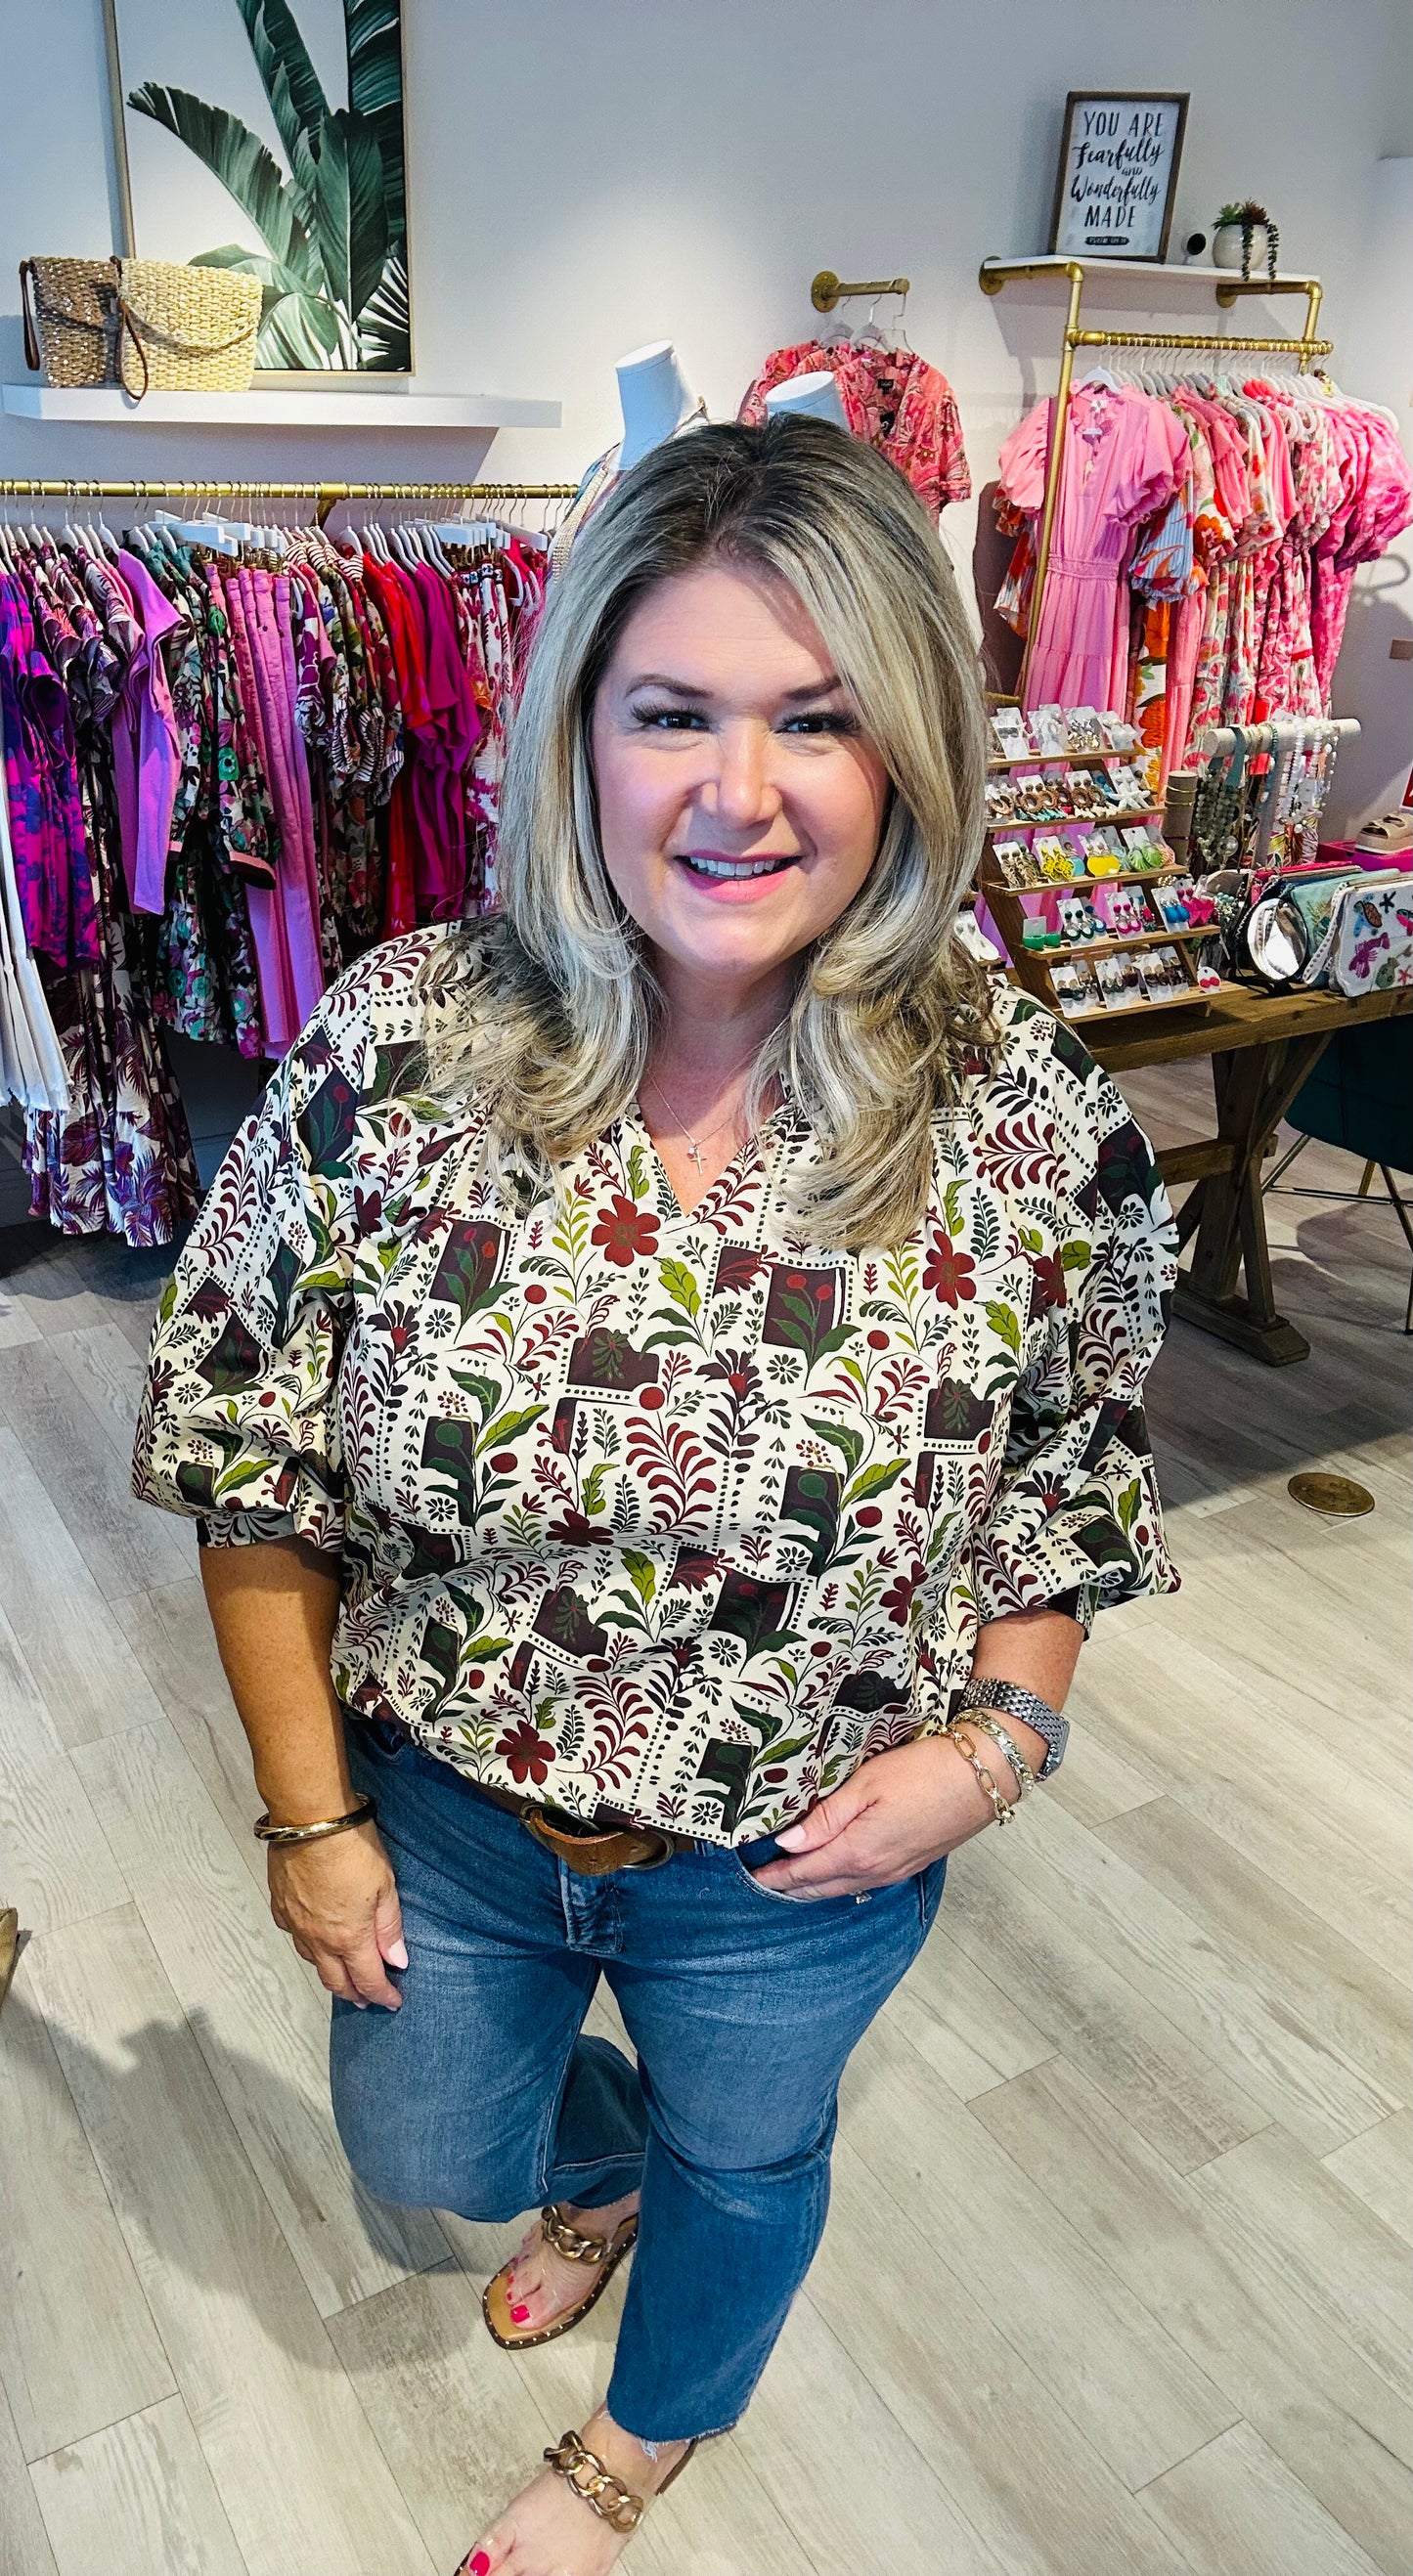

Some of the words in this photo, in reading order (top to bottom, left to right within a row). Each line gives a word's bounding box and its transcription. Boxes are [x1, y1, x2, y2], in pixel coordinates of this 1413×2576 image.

[1084, 110, 1120, 136] YOU
[1128, 112, 1164, 137] ARE
[1072, 137, 1165, 170] Fearfully
[1071, 174, 1160, 205] Wonderfully
[1083, 205, 1136, 227] MADE
